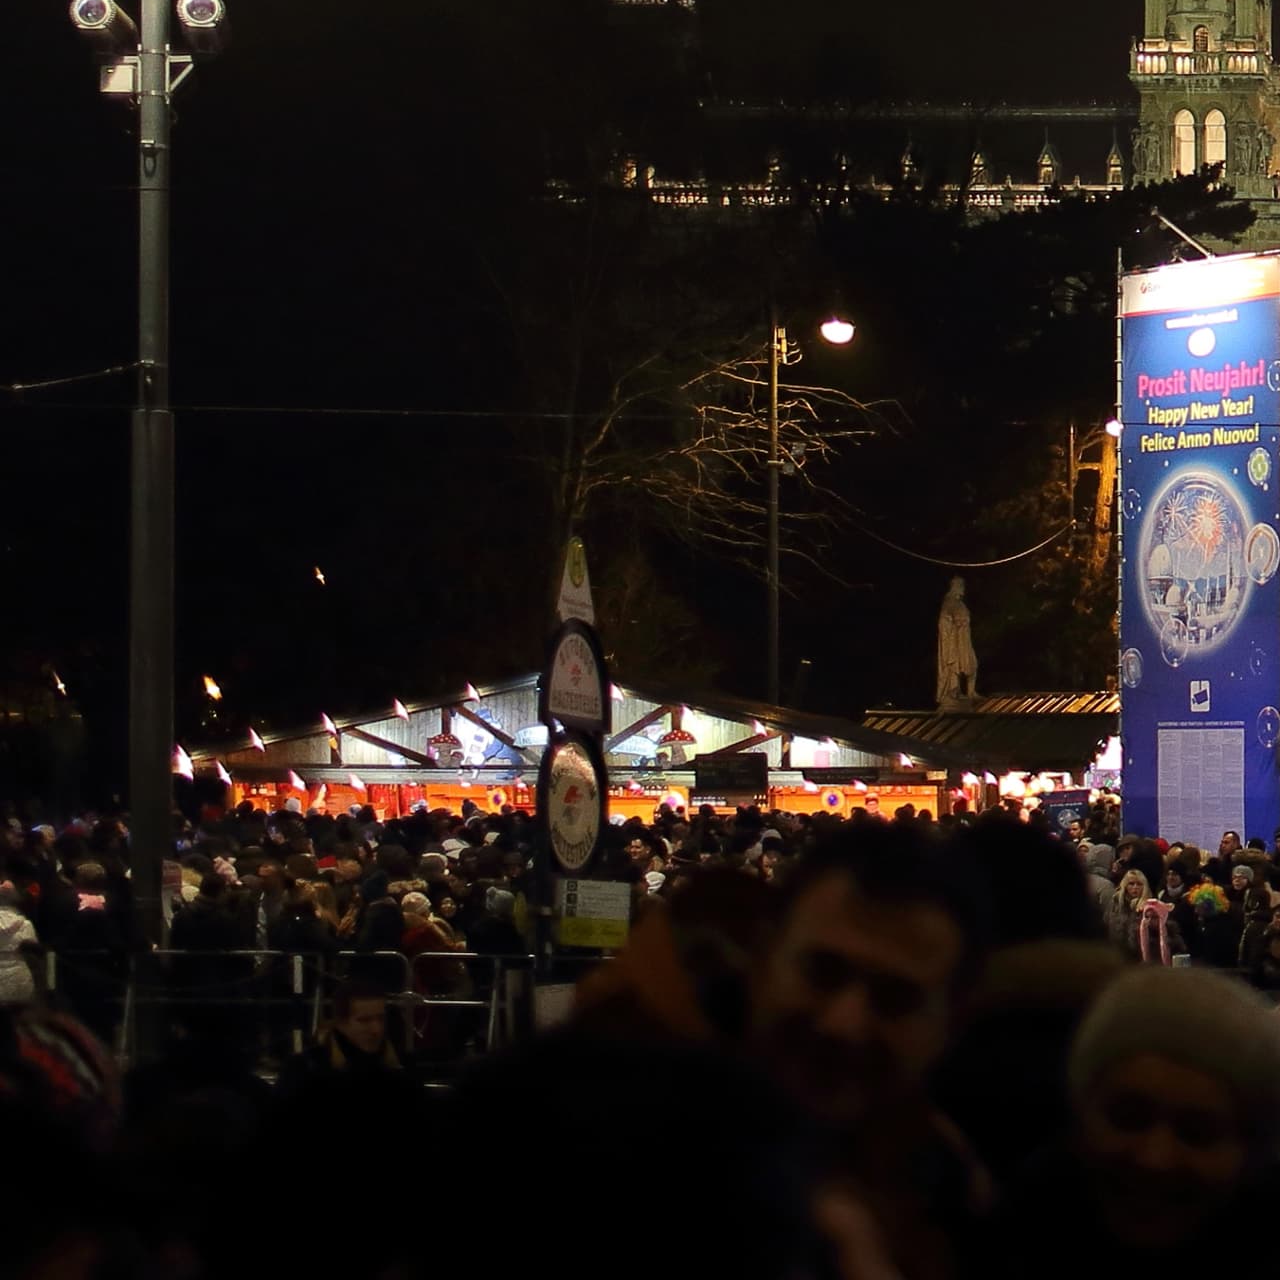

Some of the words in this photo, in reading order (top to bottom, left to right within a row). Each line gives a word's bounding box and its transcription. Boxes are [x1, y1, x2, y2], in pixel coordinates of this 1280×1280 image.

[1138, 370, 1186, 398] Prosit
[1190, 359, 1265, 397] Neujahr!
[1148, 406, 1189, 428] Happy
[1190, 401, 1219, 421] New
[1222, 395, 1254, 417] Year!
[1141, 432, 1175, 452] Felice
[1177, 429, 1211, 449] Anno
[1213, 423, 1260, 445] Nuovo!
